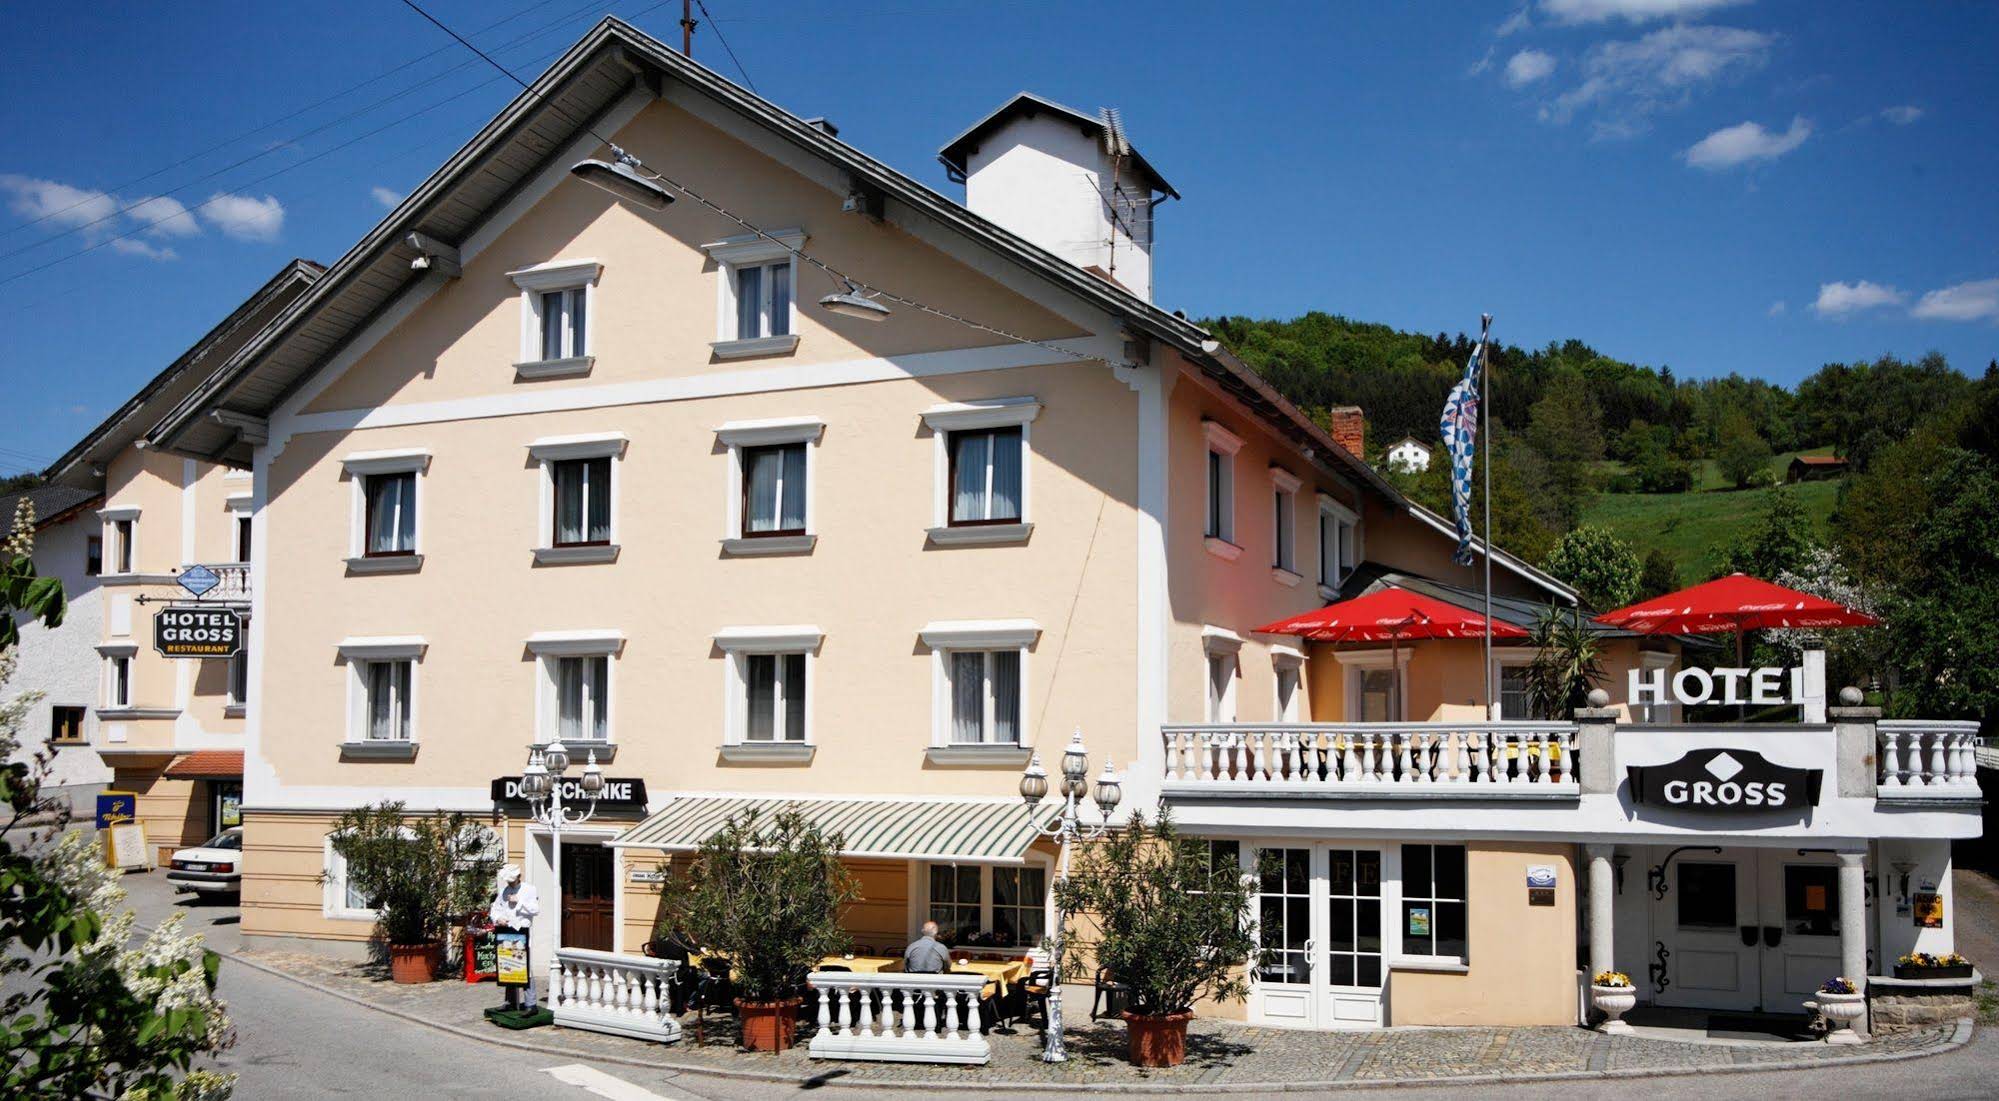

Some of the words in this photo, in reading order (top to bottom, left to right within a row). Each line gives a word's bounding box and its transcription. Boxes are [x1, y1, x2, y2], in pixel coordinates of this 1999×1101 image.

[162, 612, 235, 626] HOTEL
[162, 627, 234, 642] GROSS
[167, 645, 230, 653] RESTAURANT
[1628, 666, 1823, 705] HOTEL
[1663, 779, 1787, 806] GROSS
